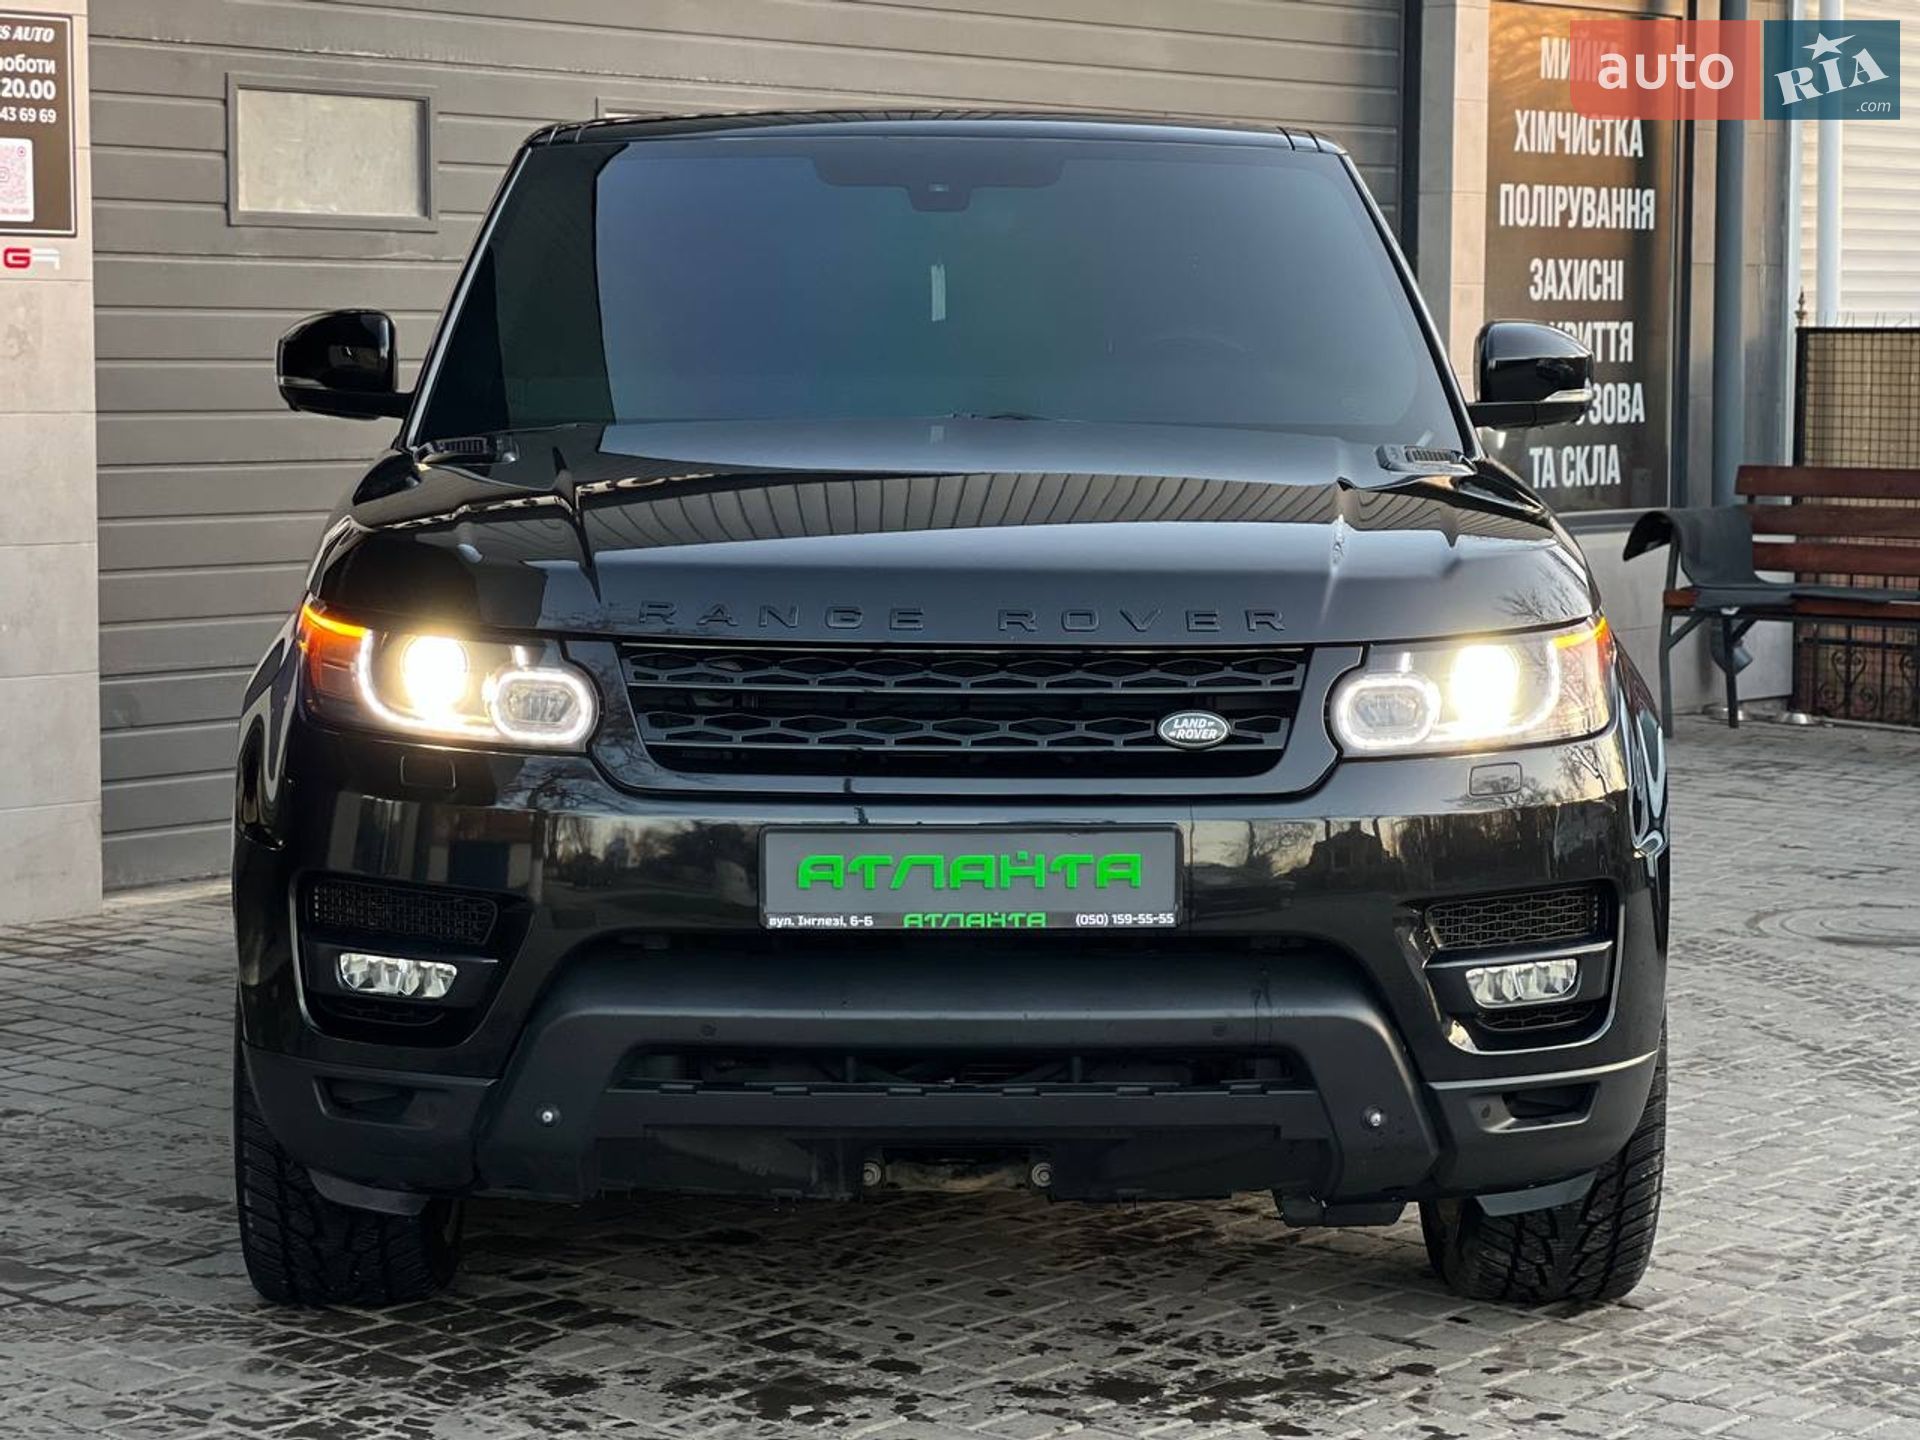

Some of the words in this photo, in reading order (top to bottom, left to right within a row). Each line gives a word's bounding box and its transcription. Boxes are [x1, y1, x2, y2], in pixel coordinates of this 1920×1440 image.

[12, 25, 55, 43] AUTO
[1, 77, 57, 100] 20.00
[19, 107, 37, 123] 69
[39, 108, 57, 124] 69
[1514, 109, 1644, 158] ХІМЧИСТКА
[1500, 184, 1656, 230] ПОЛІРУВАННЯ
[1529, 259, 1624, 302] ЗАХИСНІ
[1576, 382, 1646, 425] ЗОВА
[1529, 447, 1557, 489] ТА
[1561, 444, 1622, 488] СКЛА
[638, 601, 925, 631] RANGE
[997, 608, 1285, 632] ROVER
[1173, 718, 1207, 729] LAND
[1176, 729, 1218, 740] ROVER
[1075, 914, 1109, 926] (050)
[1112, 913, 1175, 925] 159-55-55
